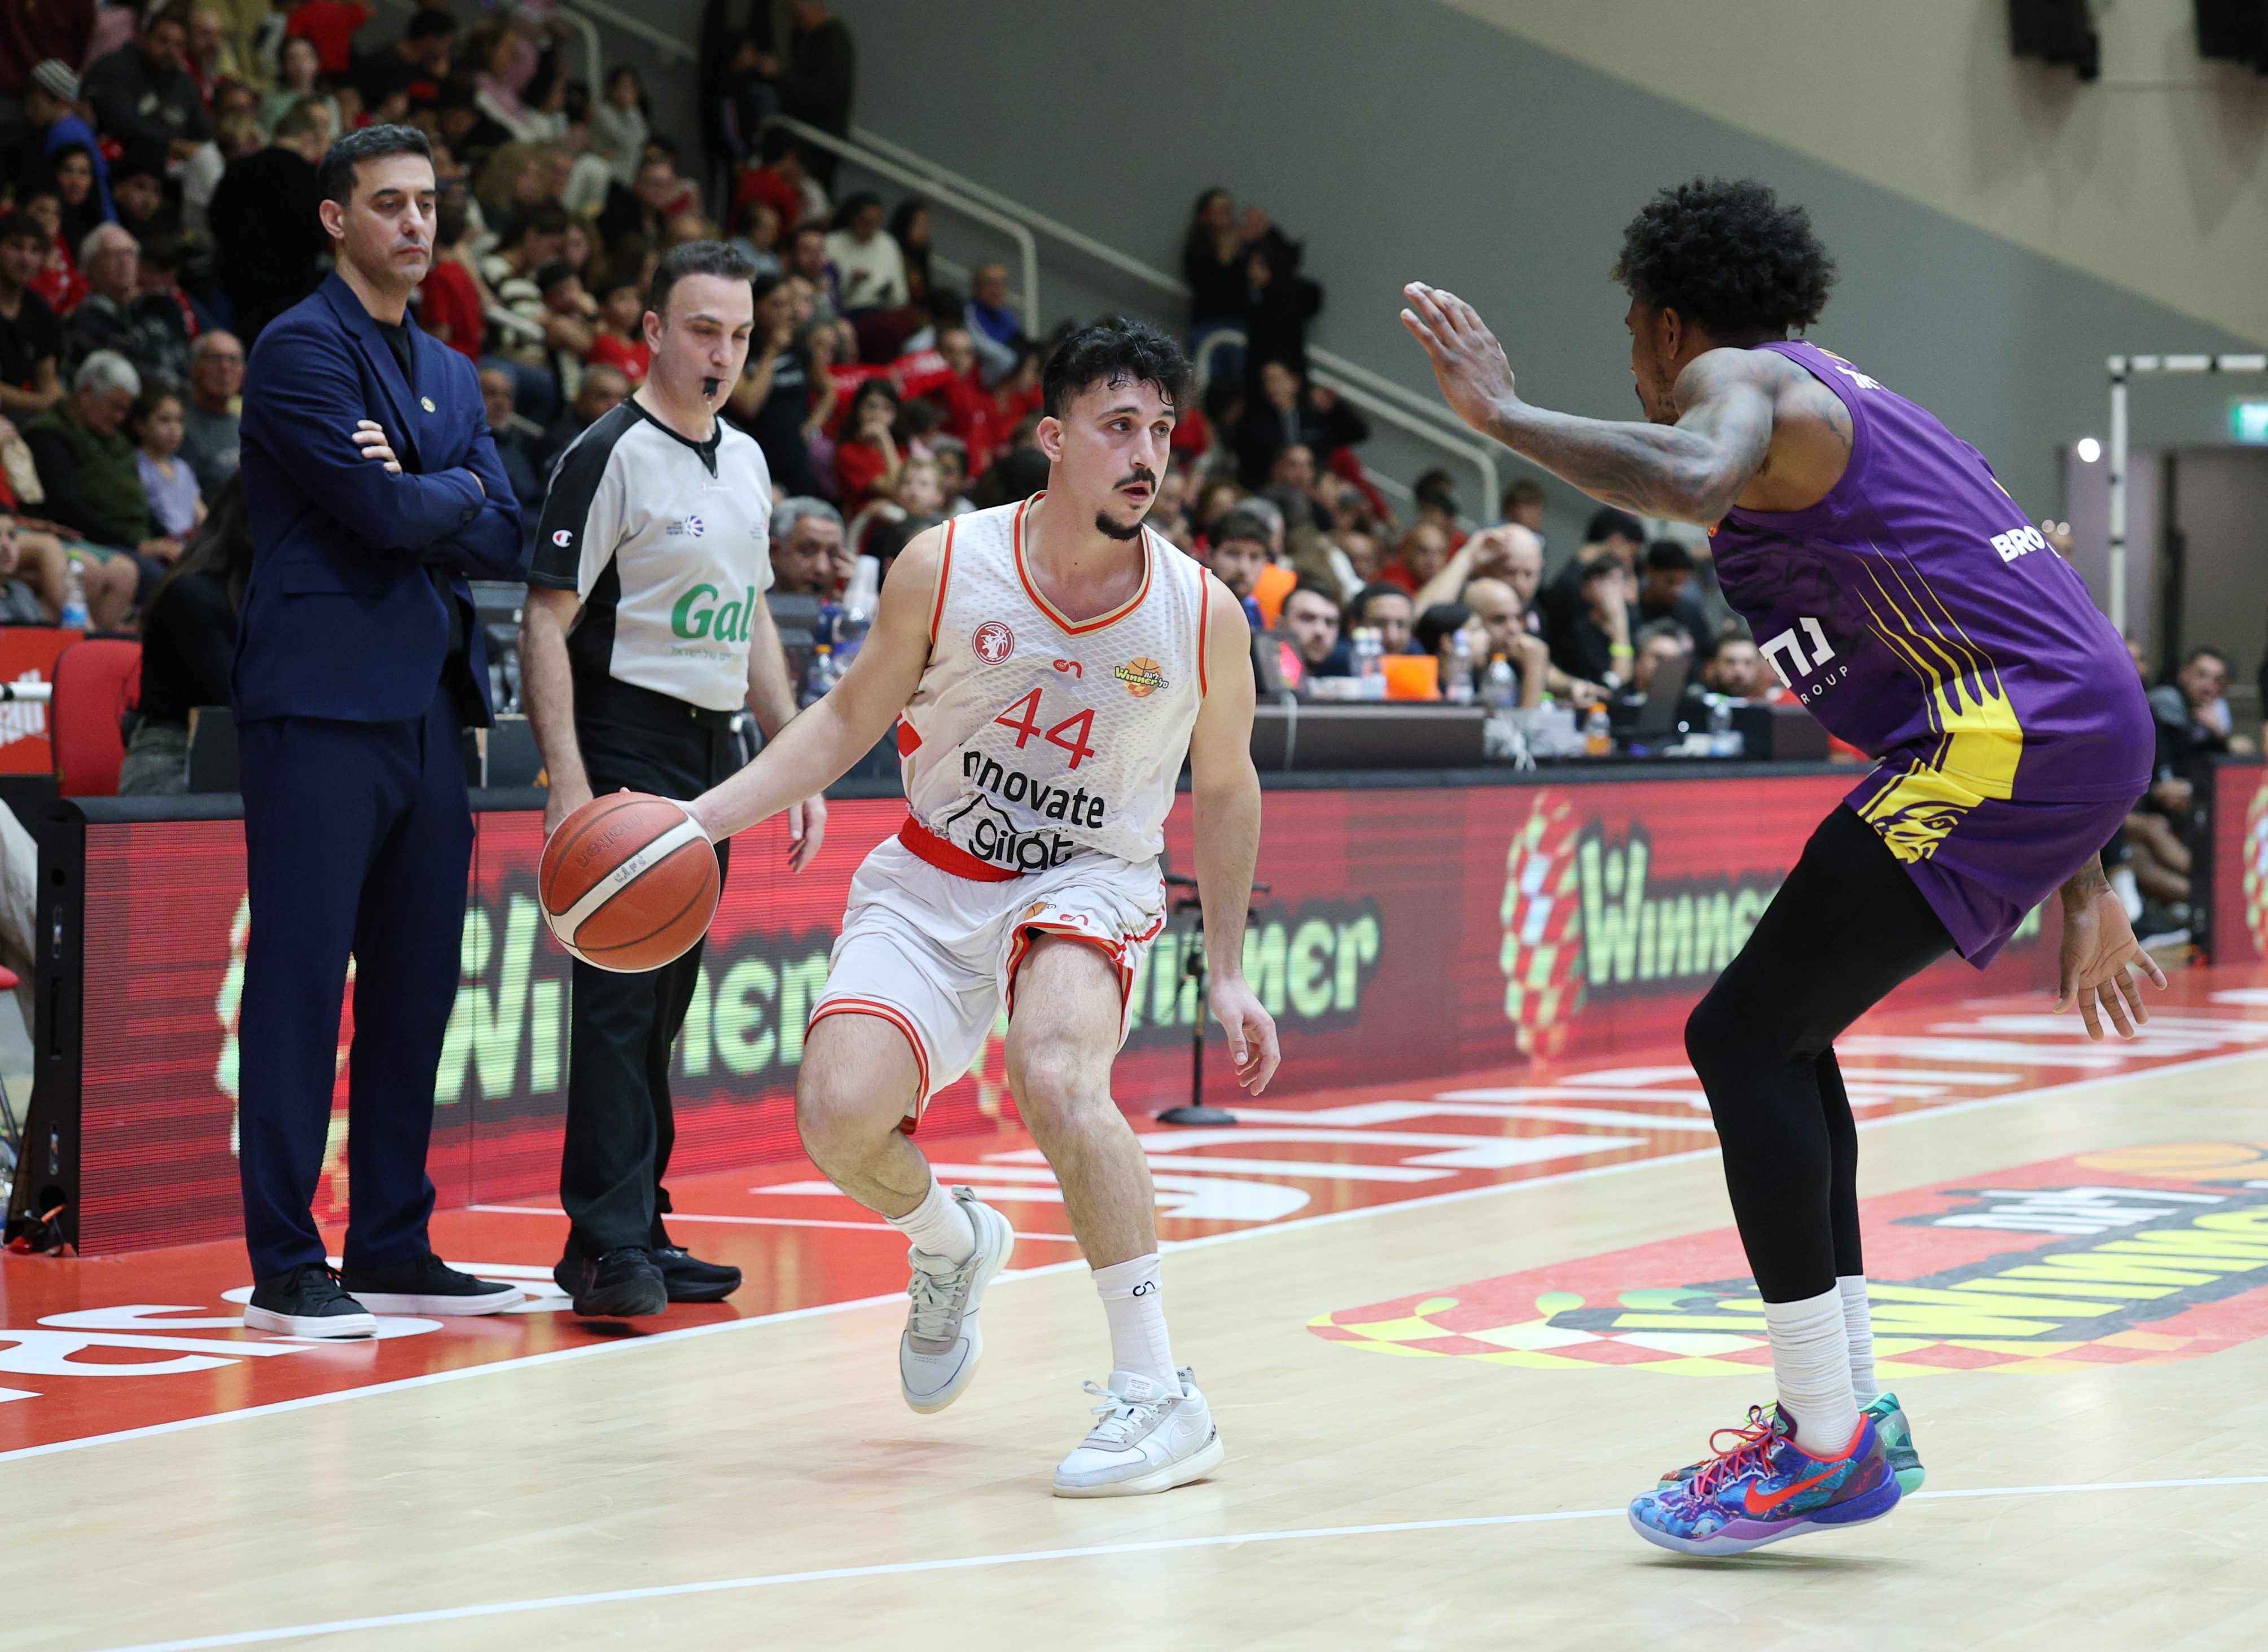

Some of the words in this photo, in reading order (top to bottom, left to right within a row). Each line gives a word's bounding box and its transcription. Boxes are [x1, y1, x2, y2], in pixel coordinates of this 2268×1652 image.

[1990, 525, 2061, 563] BRO
[671, 583, 754, 642] Gal
[1115, 666, 1158, 686] Winner
[1800, 666, 1848, 705] ROUP
[994, 688, 1095, 770] 44
[961, 744, 1105, 829] nnovate
